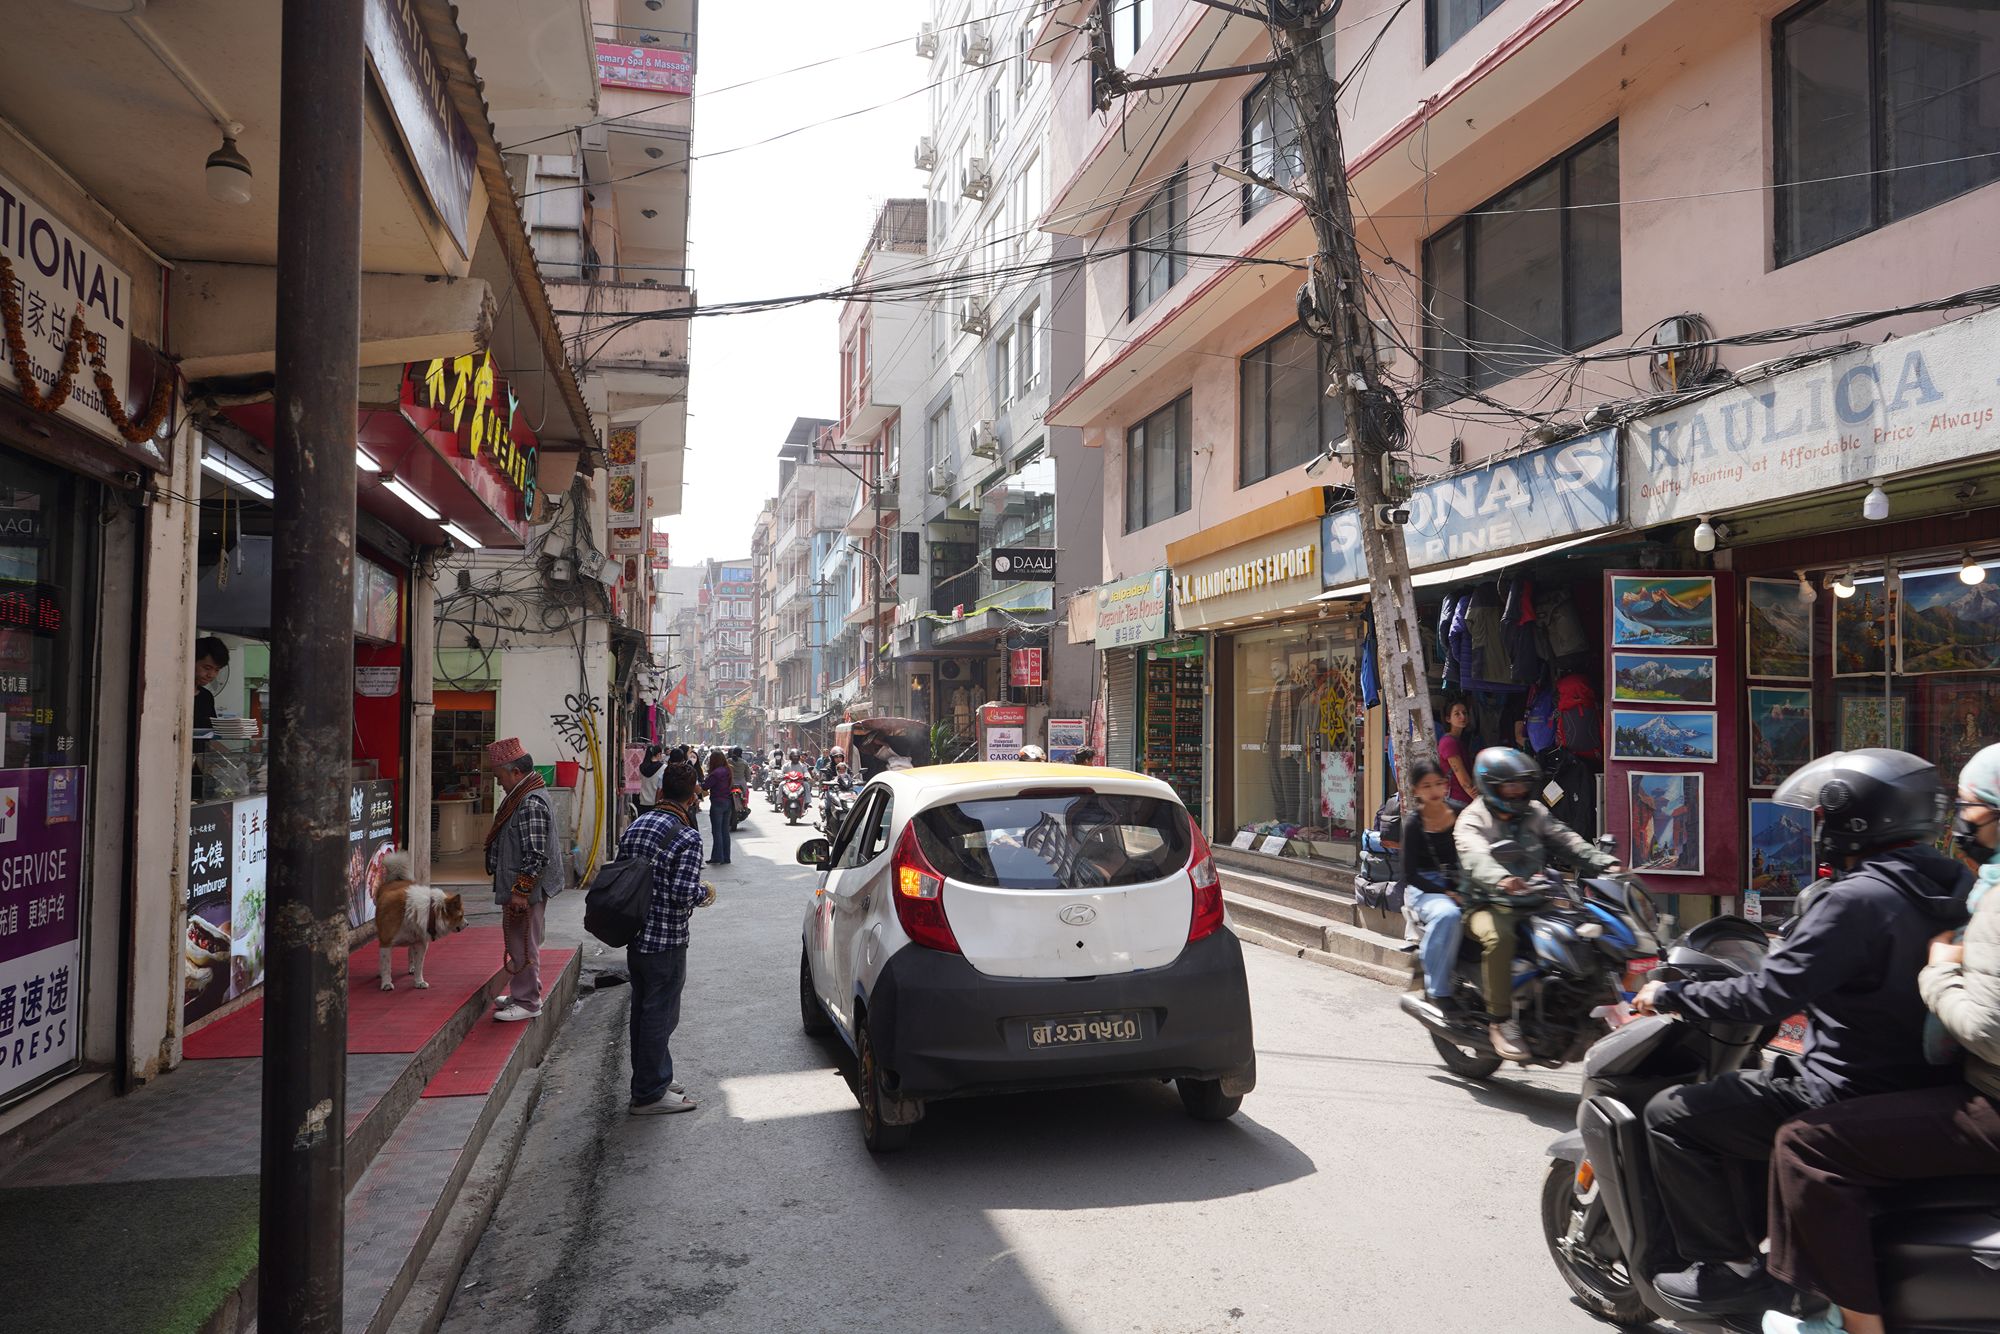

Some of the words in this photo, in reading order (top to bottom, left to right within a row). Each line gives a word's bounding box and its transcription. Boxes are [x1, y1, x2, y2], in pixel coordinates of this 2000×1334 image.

[627, 55, 643, 66] Spa
[645, 58, 652, 67] &
[654, 59, 690, 73] Massage
[0, 185, 124, 330] TIONAL
[1646, 350, 1944, 473] KAULICA
[1640, 478, 1681, 499] Quality
[1690, 465, 1743, 487] Painting
[1752, 456, 1768, 472] at
[1779, 434, 1861, 471] Affordable
[1873, 425, 1915, 445] Price
[1929, 407, 1994, 435] Always
[1330, 436, 1604, 556] SONA'S
[1013, 556, 1053, 569] DAALI
[1194, 559, 1265, 602] HANDICRAFTS
[1265, 544, 1315, 584] EXPORT
[1098, 607, 1124, 631] Organic
[1125, 602, 1138, 621] Tea
[1139, 599, 1164, 619] House
[56, 735, 75, 752] 徒步
[989, 753, 1020, 761] CARGO
[2, 848, 67, 892] SERVISE
[193, 877, 228, 897] Hamburger
[28, 892, 65, 930] 更换户名
[0, 965, 69, 1039] 通速递
